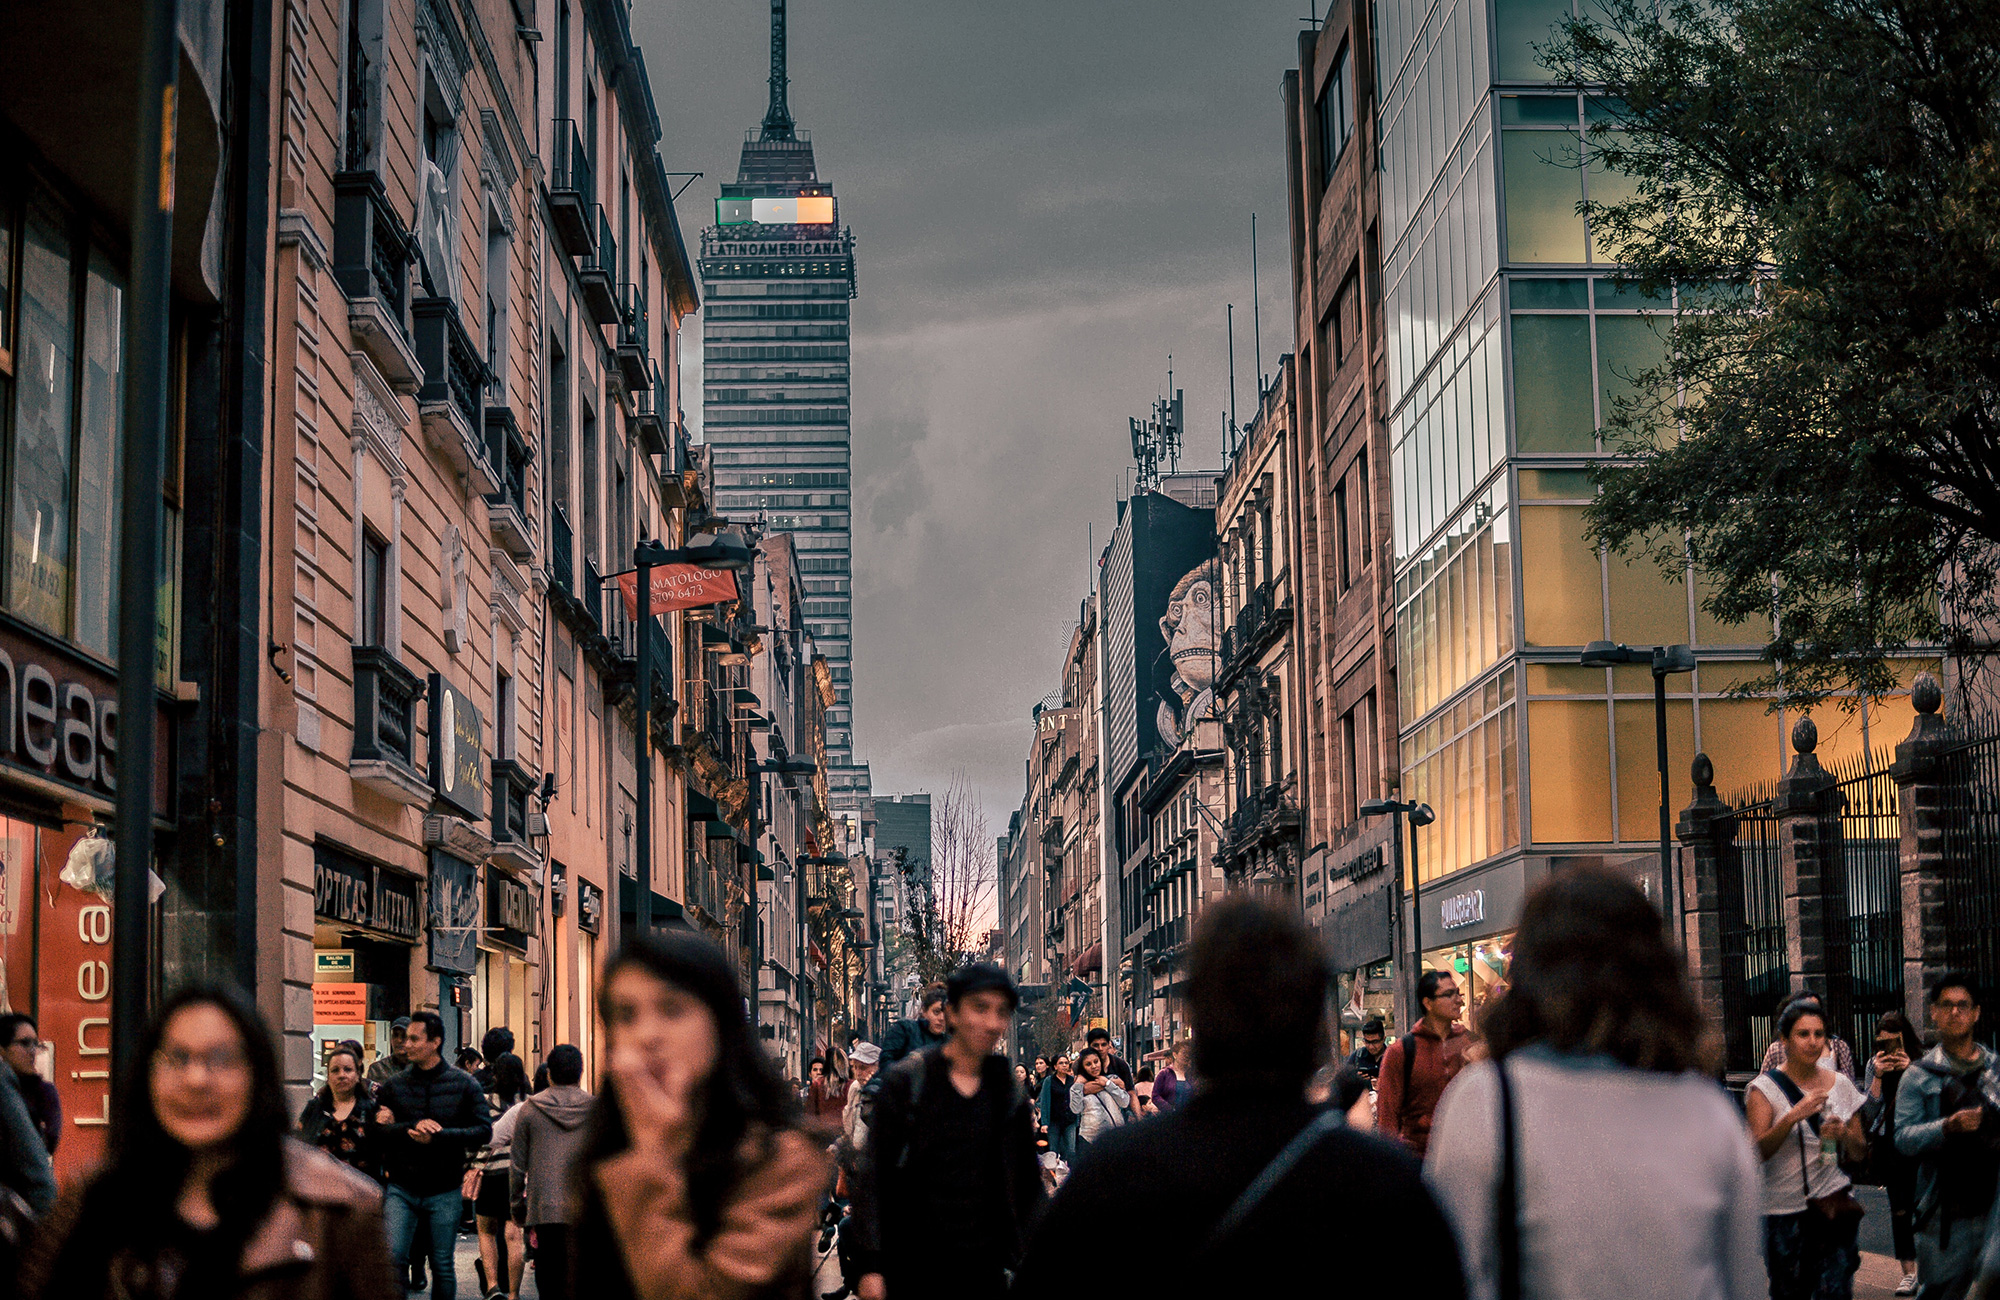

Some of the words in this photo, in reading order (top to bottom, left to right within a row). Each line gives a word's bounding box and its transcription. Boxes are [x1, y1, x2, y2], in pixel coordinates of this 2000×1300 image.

[710, 243, 842, 255] LATINOAMERICANA
[630, 568, 722, 596] DMATÓLOGO
[651, 590, 675, 605] 5709
[677, 584, 704, 600] 6473
[314, 863, 367, 924] OPTICAS
[71, 905, 111, 1125] Linea
